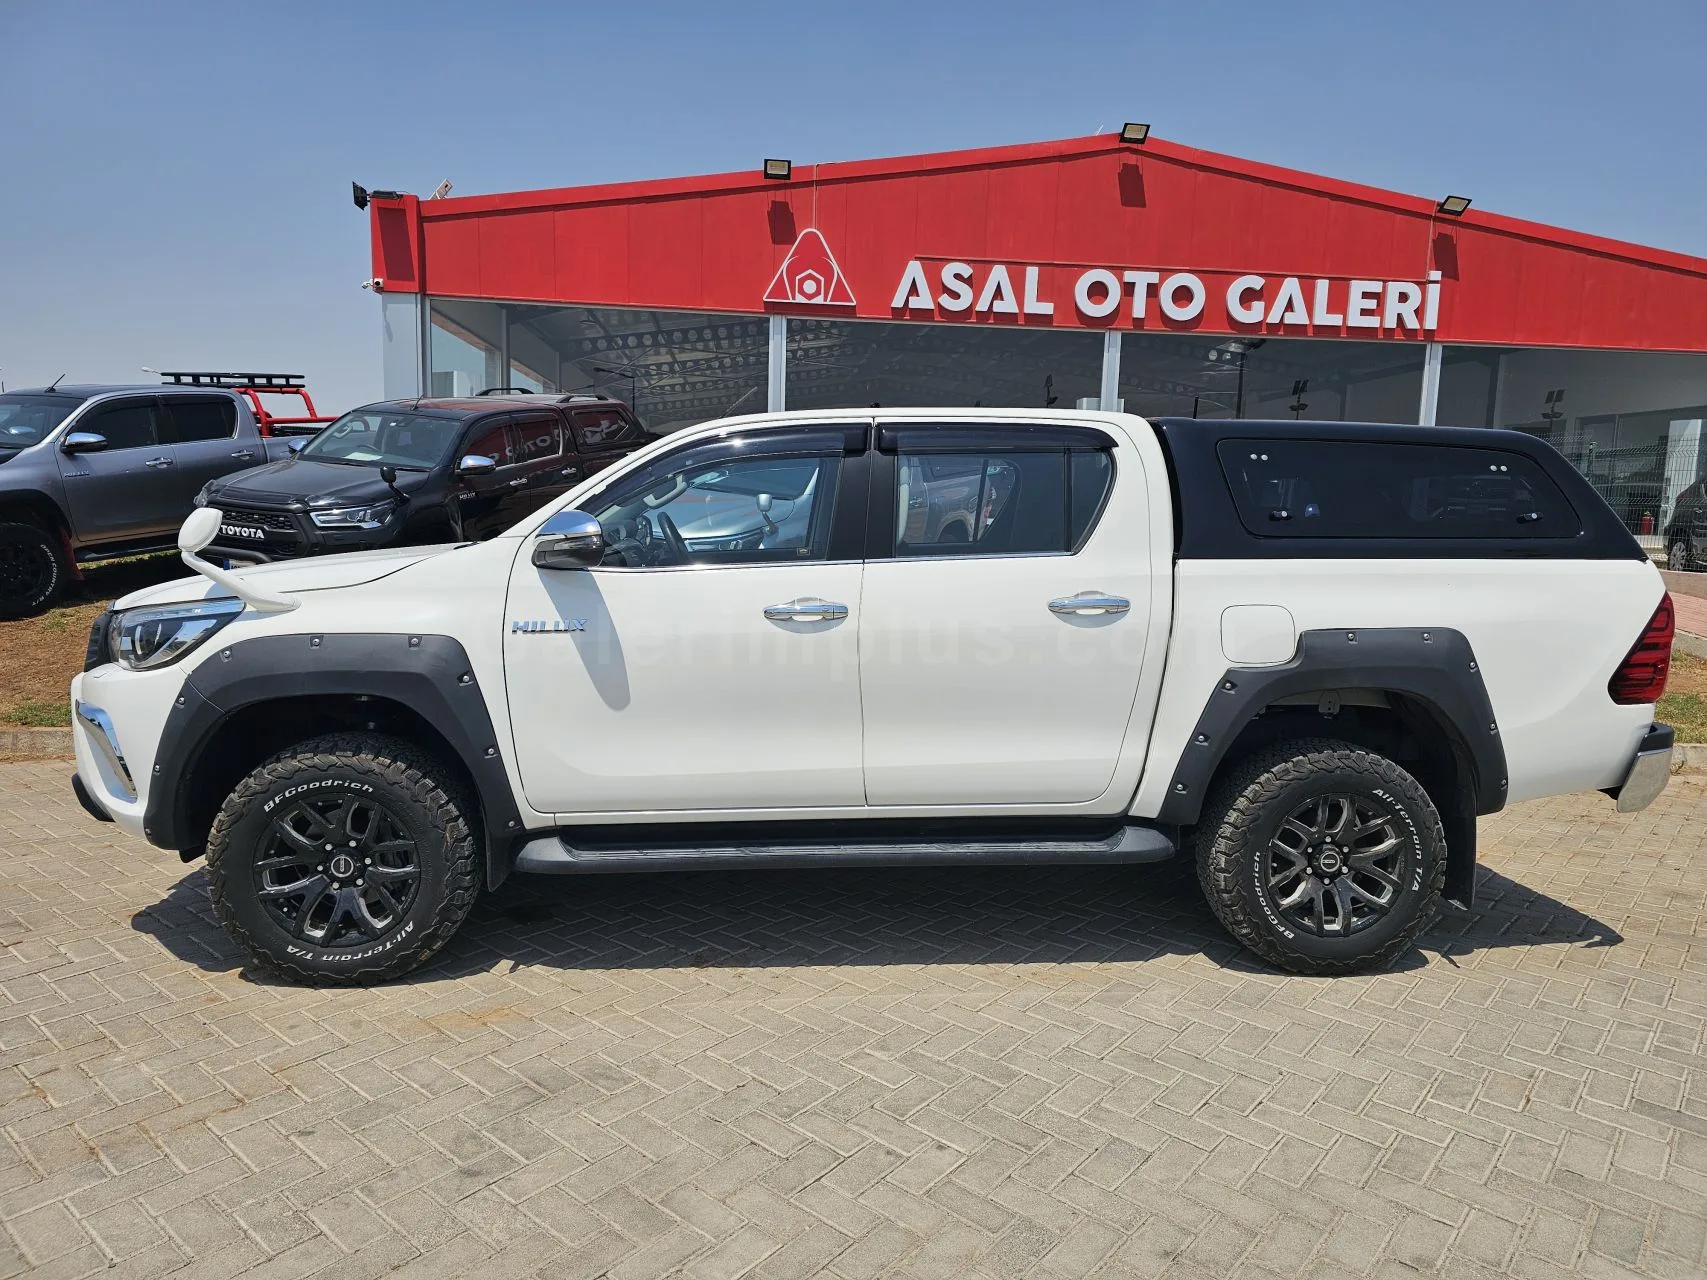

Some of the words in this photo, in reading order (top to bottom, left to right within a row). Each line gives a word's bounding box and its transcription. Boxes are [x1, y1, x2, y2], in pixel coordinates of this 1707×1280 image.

[890, 260, 1054, 315] ASAL
[1074, 268, 1206, 321] OTO
[1226, 270, 1441, 330] GALERİ
[220, 525, 265, 539] TOYOTA
[511, 618, 588, 633] HILUX
[263, 778, 375, 813] BFGoodrich
[1371, 788, 1423, 862] All-Terrain
[1411, 864, 1425, 892] T/A
[1252, 851, 1295, 940] BFGoodrich
[286, 944, 314, 960] T/A
[322, 920, 415, 962] All-Terrain
